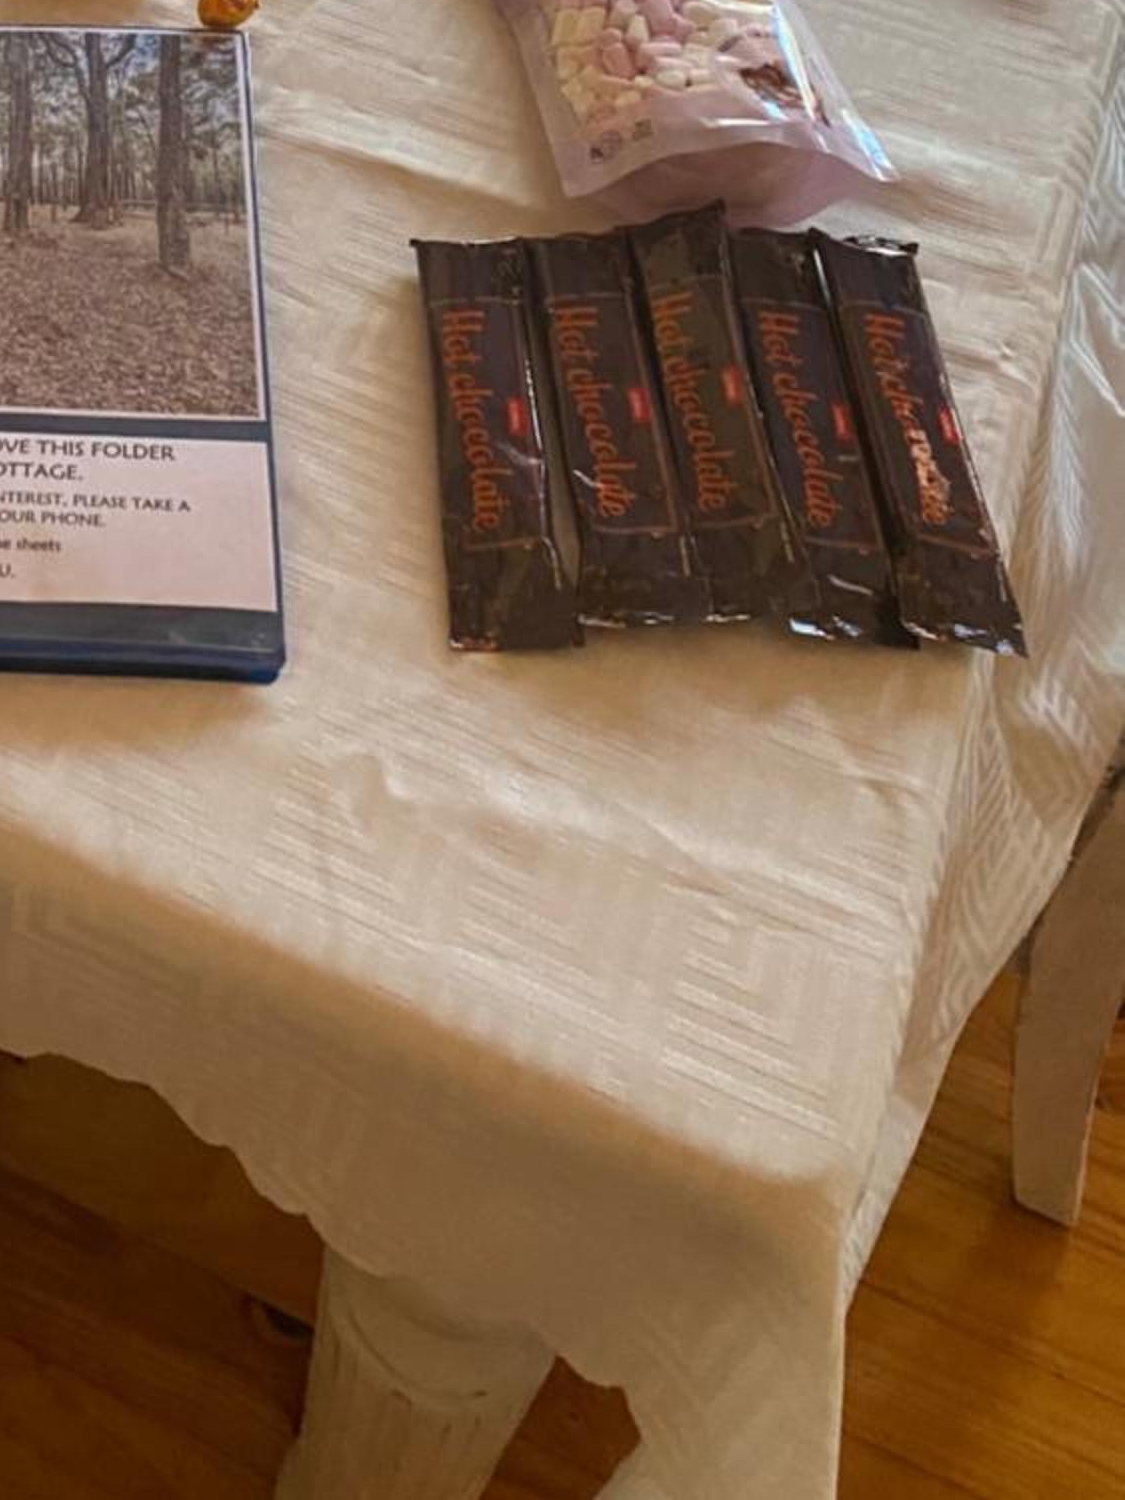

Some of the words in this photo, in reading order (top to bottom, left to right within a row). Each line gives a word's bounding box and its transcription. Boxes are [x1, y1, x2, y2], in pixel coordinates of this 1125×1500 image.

[442, 308, 485, 366] Hot
[556, 305, 599, 360] Hot
[652, 291, 695, 348] Hot
[759, 310, 804, 366] Hot
[864, 313, 908, 370] Hot
[37, 440, 85, 457] THIS
[91, 442, 176, 461] FOLDER
[448, 373, 514, 533] chocolate
[568, 368, 637, 518] chocolate
[662, 355, 734, 513] chocolate
[773, 371, 844, 528] chocolate
[40, 511, 106, 527] PHONE.
[72, 493, 128, 509] PLEASE
[132, 496, 174, 512] TAKE
[178, 500, 192, 512] A
[16, 537, 62, 552] sheets
